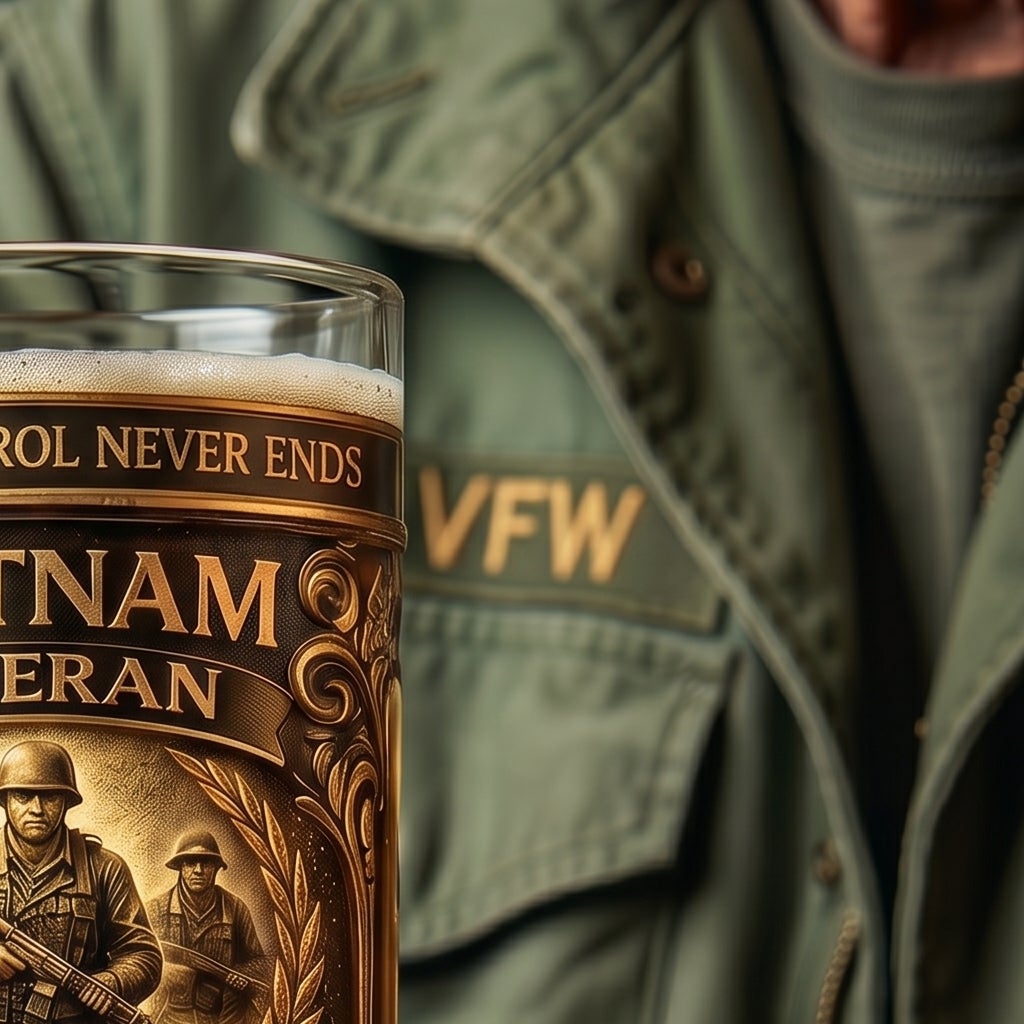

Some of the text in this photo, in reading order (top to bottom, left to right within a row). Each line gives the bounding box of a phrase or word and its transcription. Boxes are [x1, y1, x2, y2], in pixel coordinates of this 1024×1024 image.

[96, 426, 251, 476] NEVER
[264, 436, 363, 488] ENDS
[419, 466, 647, 582] VFW
